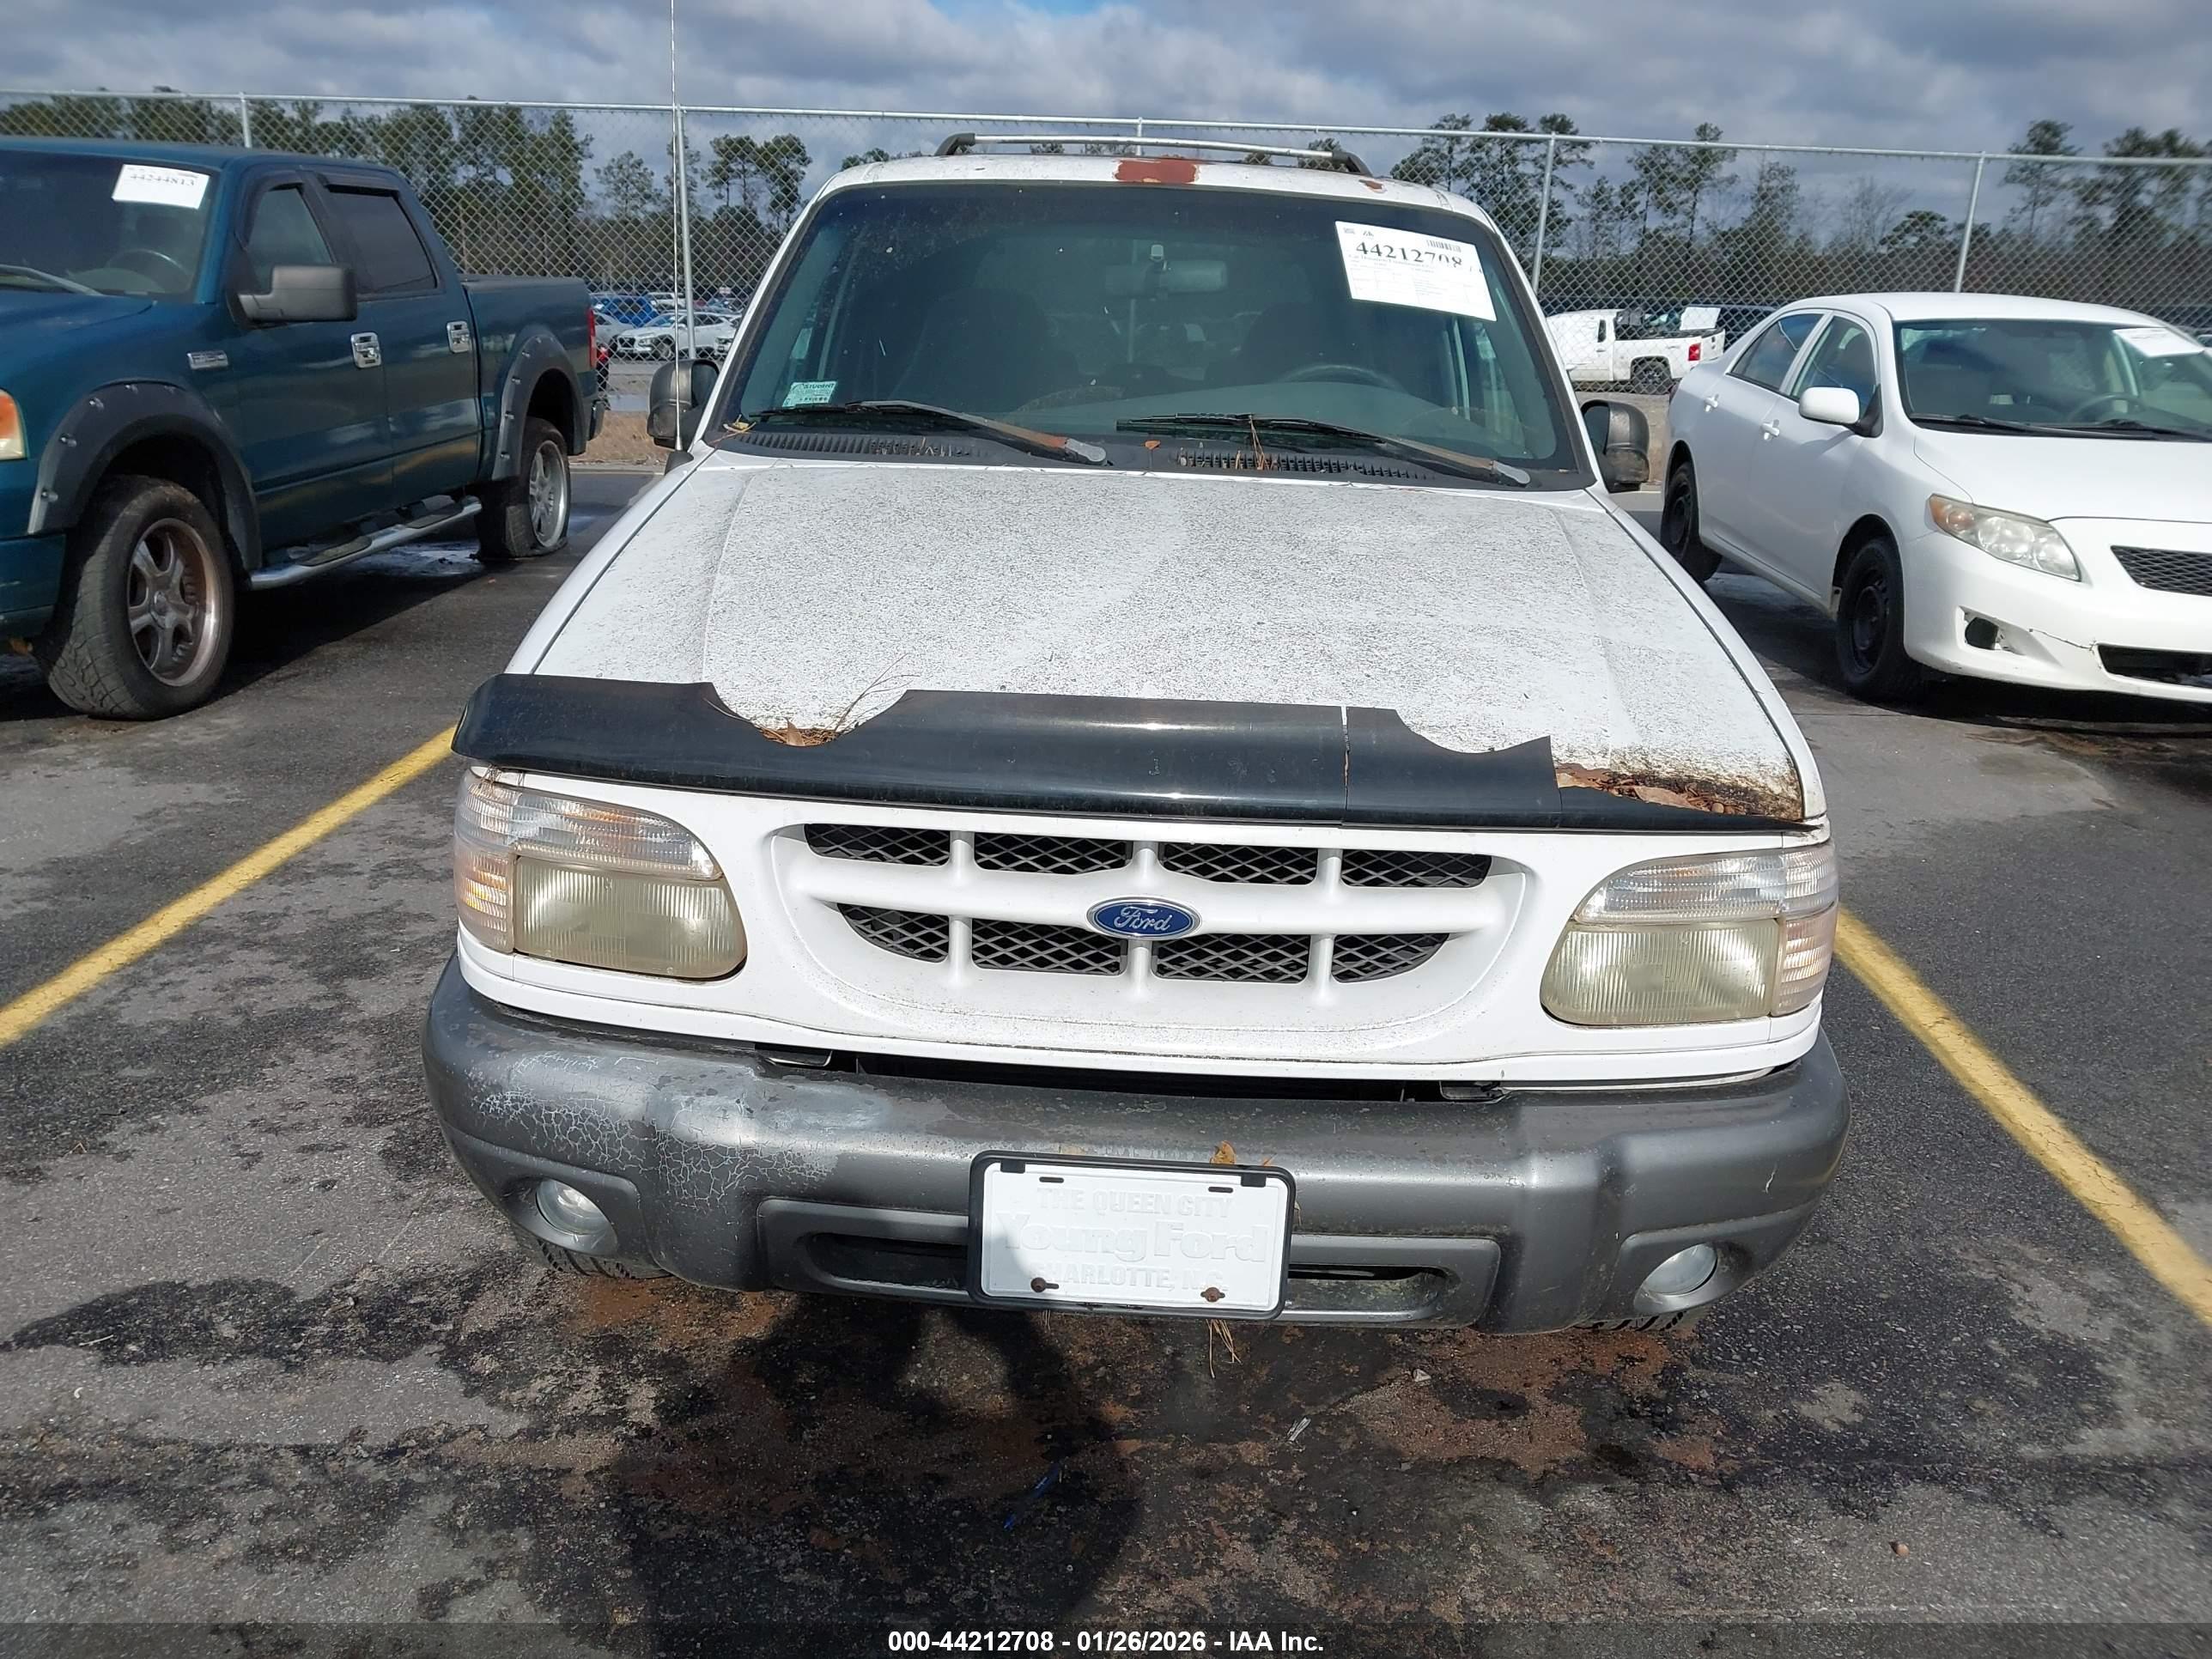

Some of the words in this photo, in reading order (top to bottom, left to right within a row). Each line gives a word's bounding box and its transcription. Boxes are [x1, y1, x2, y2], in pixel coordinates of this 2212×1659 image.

[1355, 241, 1463, 268] 44212708
[1113, 906, 1173, 932] Ford
[1036, 1187, 1085, 1210] THE
[1092, 1189, 1176, 1216] QUEEN
[1177, 1194, 1233, 1218] CITY
[995, 1212, 1148, 1263] Young
[1153, 1220, 1269, 1262] Ford
